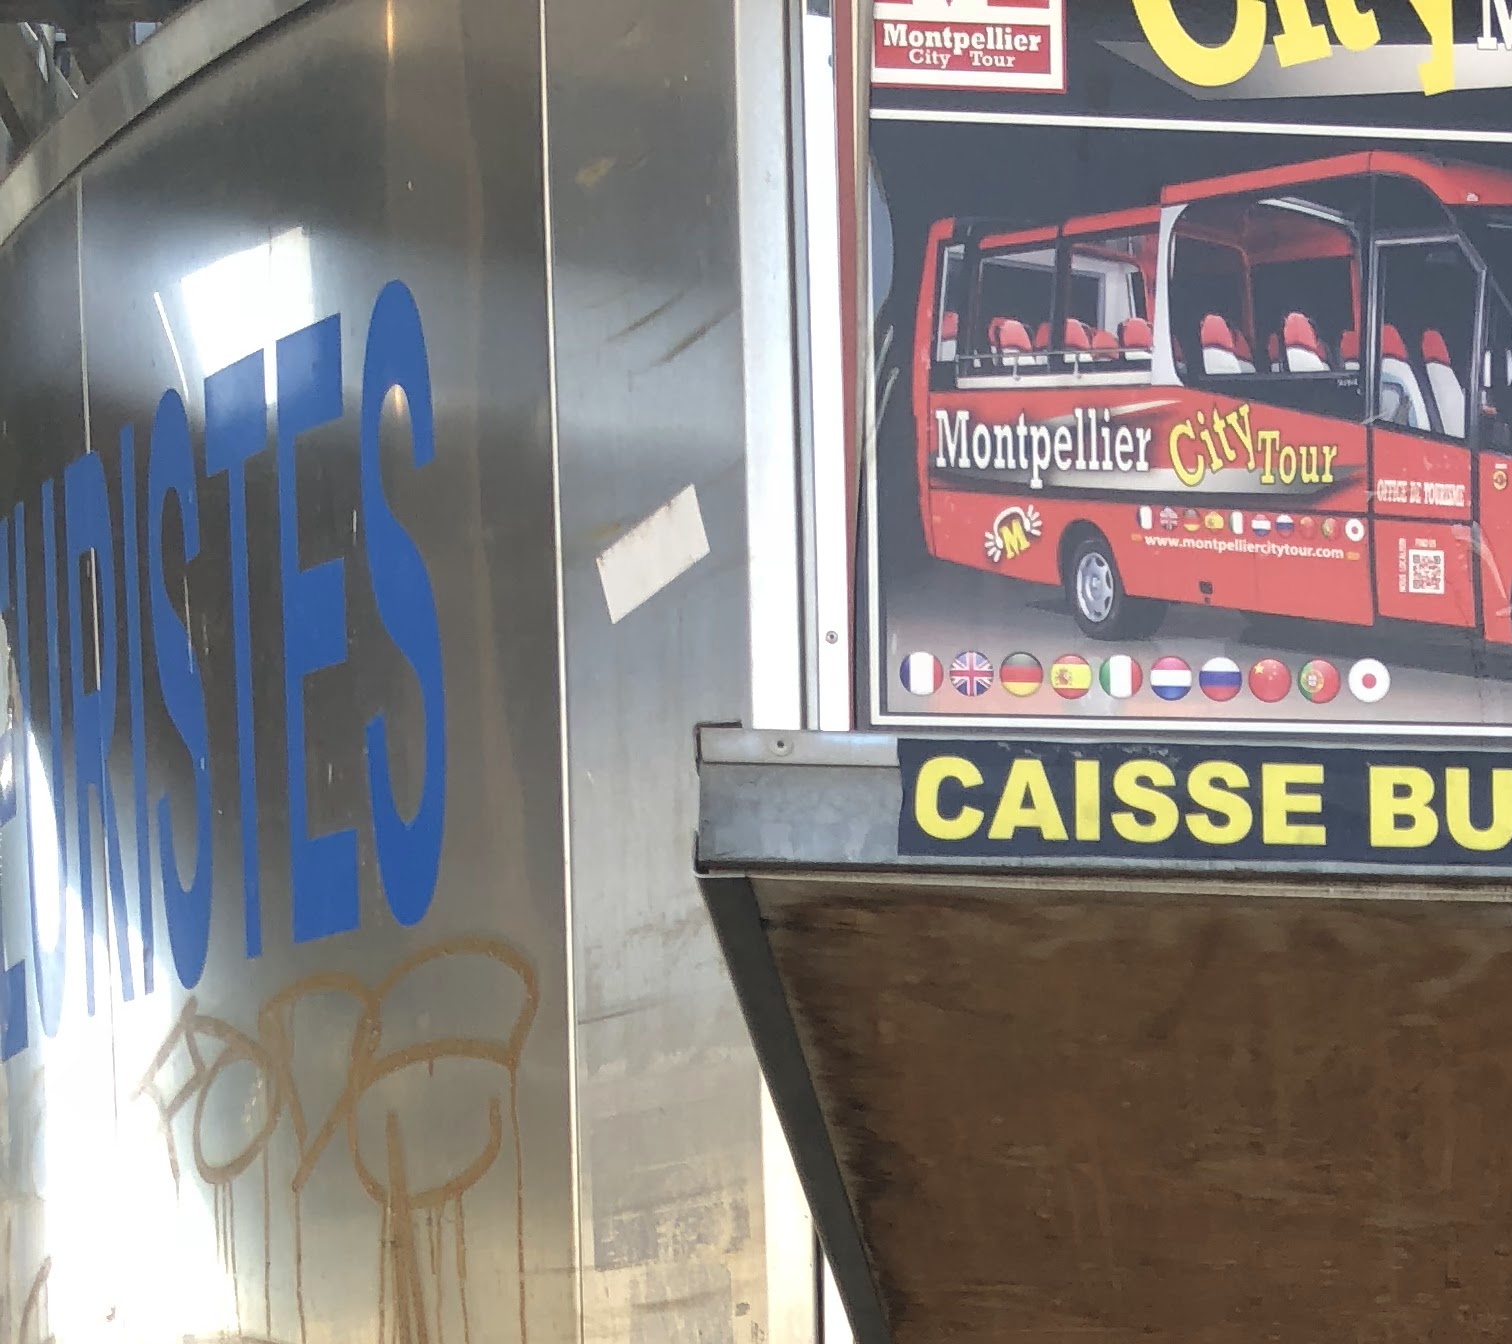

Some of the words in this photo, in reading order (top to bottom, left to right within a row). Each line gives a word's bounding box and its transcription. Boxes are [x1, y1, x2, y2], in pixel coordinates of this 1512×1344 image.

[883, 23, 1042, 56] Montpellier
[908, 48, 951, 69] City
[969, 50, 1017, 68] Tour
[935, 407, 1152, 490] Montpellier
[1168, 402, 1256, 488] City
[1257, 430, 1338, 485] Tour
[1144, 534, 1345, 560] www.montpelliercitytour.com
[0, 278, 447, 1063] URISTES
[913, 754, 1327, 847] CAISSE
